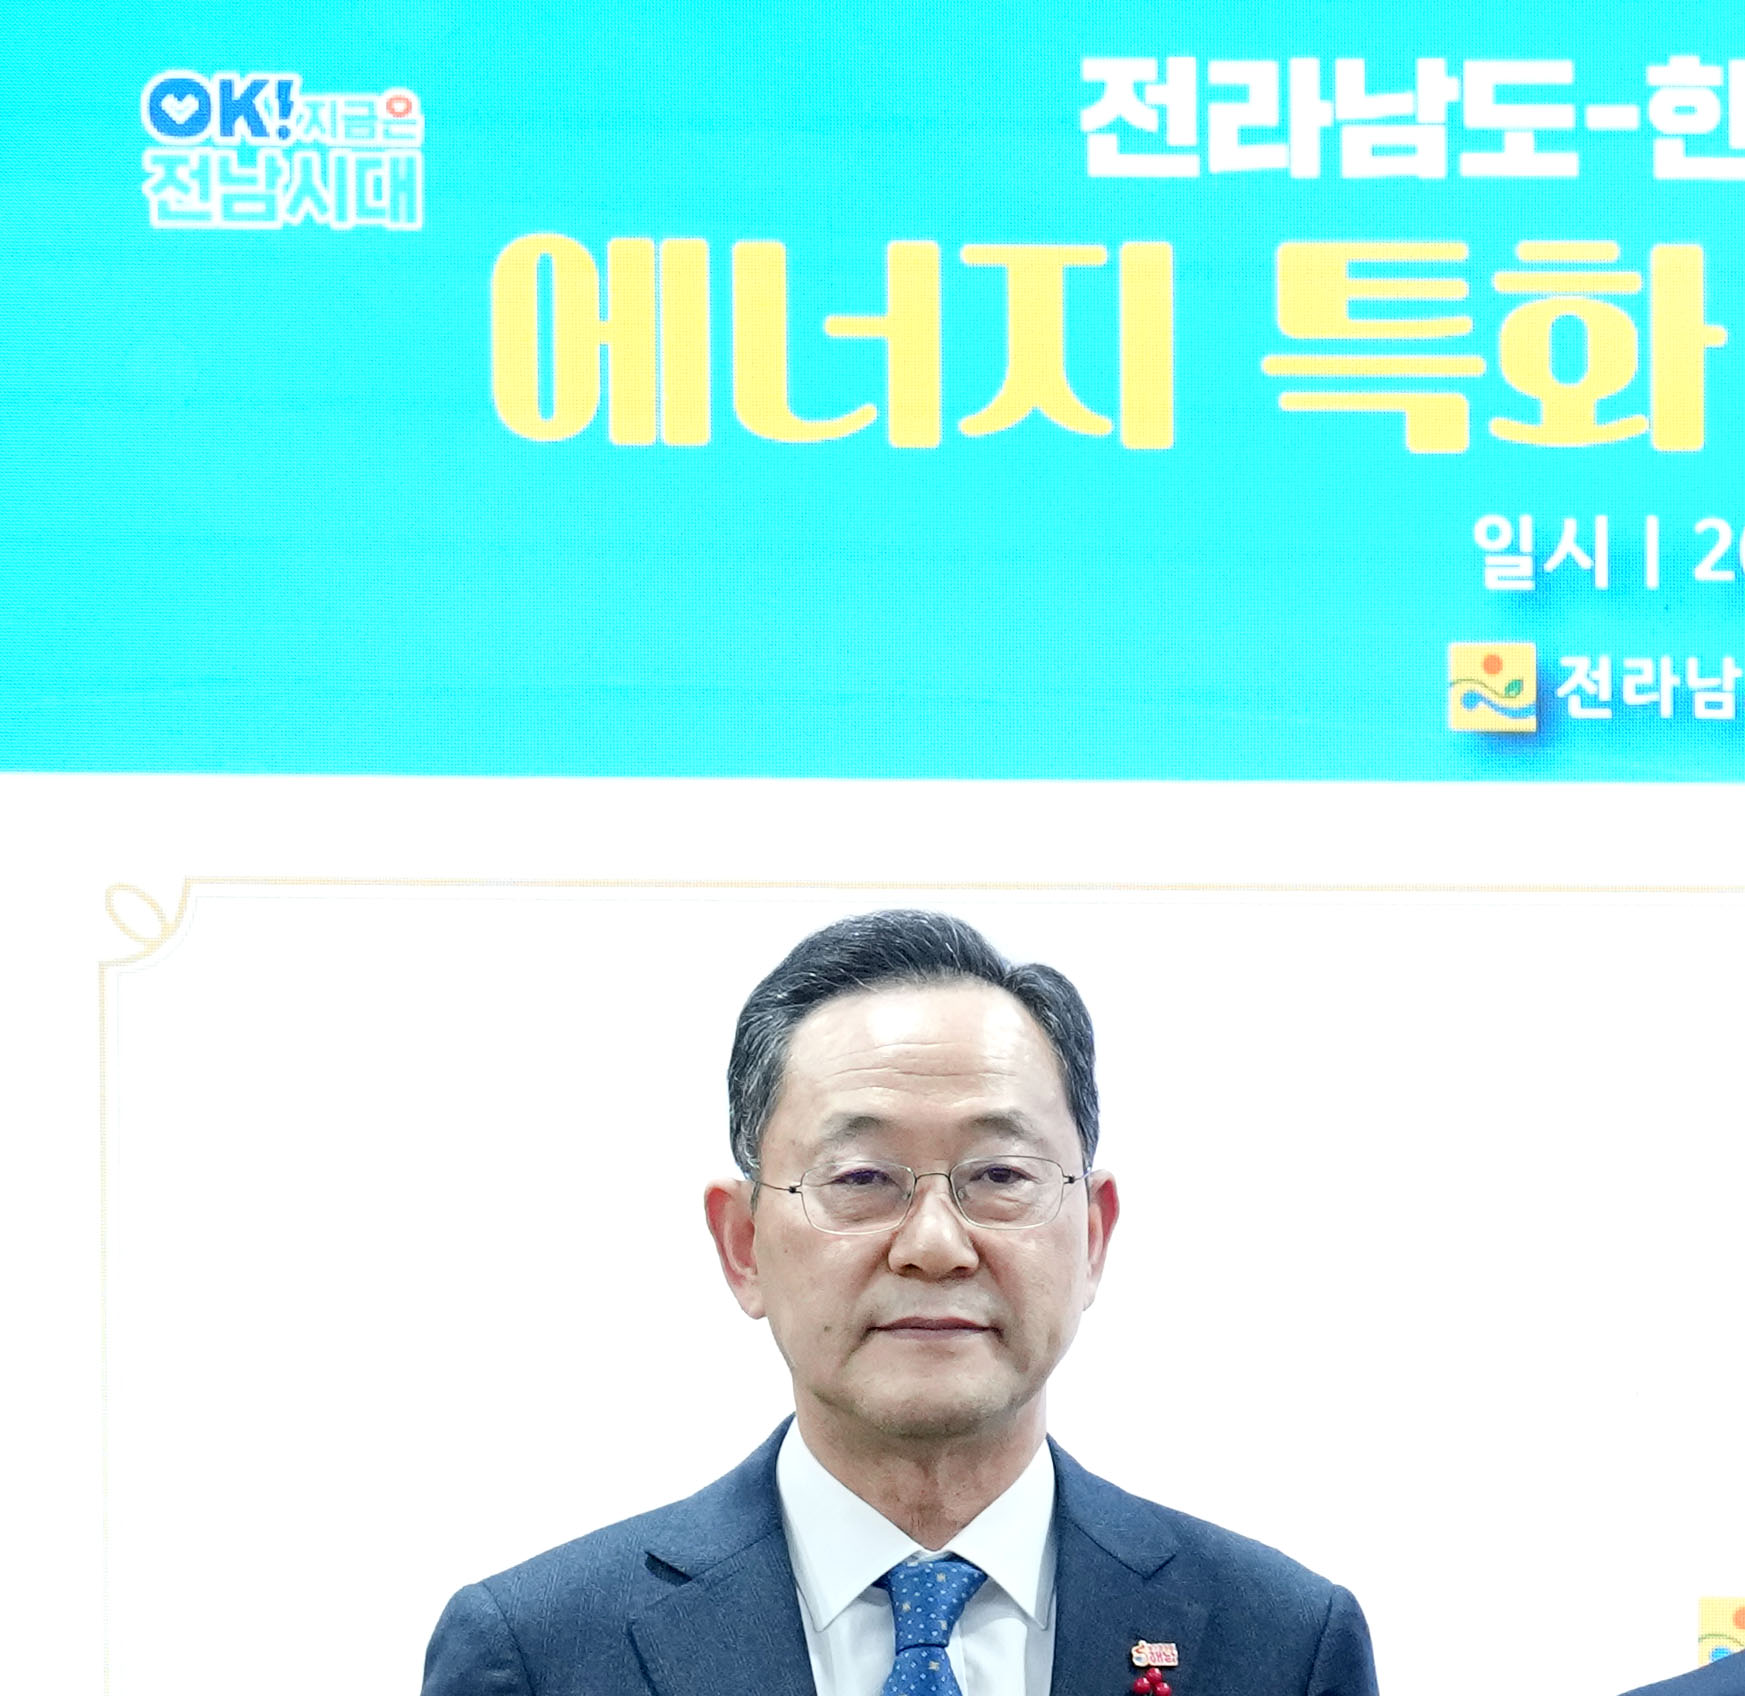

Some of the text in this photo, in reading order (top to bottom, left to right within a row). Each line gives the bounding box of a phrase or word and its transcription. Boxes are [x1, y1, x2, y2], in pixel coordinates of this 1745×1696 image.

[143, 149, 423, 229] 전남시대
[490, 232, 1175, 450] 에너지
[1260, 239, 1729, 455] 특화
[1474, 514, 1608, 590] 일시
